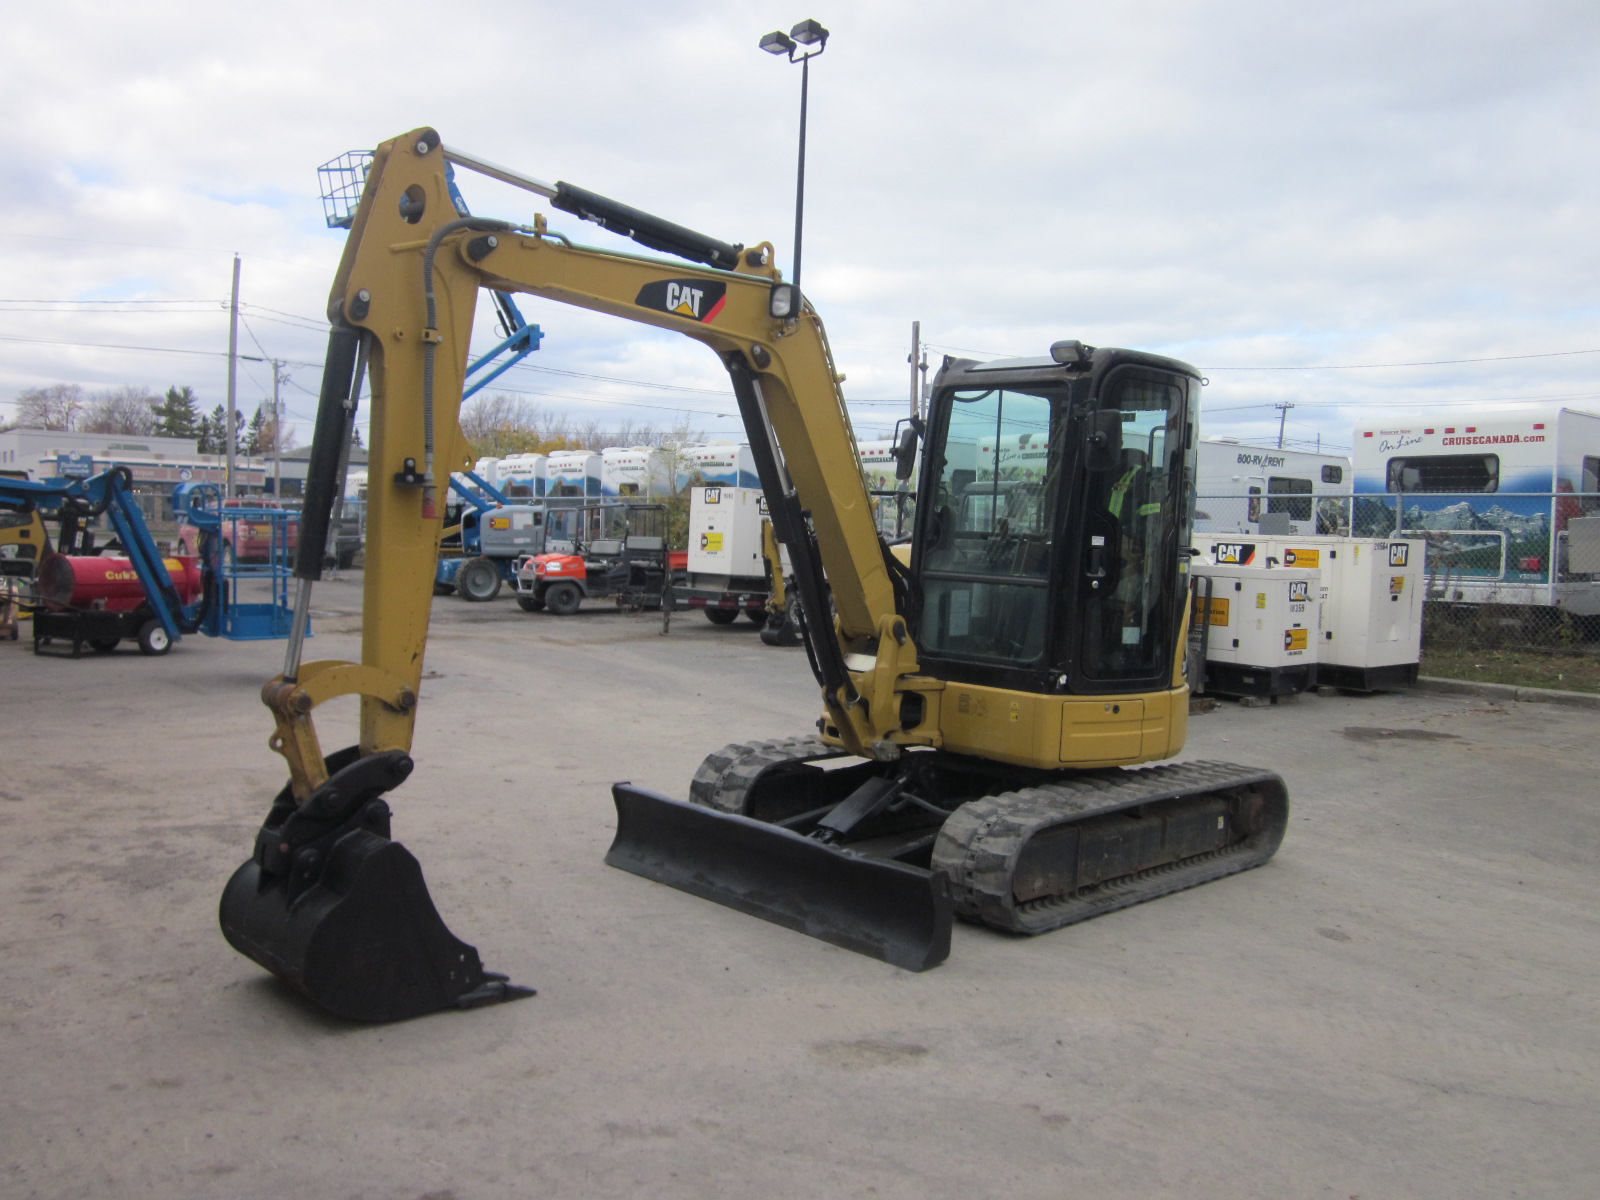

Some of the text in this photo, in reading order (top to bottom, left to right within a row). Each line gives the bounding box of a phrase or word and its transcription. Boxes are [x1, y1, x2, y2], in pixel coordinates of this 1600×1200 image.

[666, 282, 704, 318] CAT
[1379, 440, 1395, 452] On
[1442, 435, 1545, 446] CRUISECANADA.com
[705, 489, 720, 503] CAT
[1217, 544, 1243, 562] CAT
[1391, 545, 1407, 565] CAT
[1290, 582, 1306, 600] CAT
